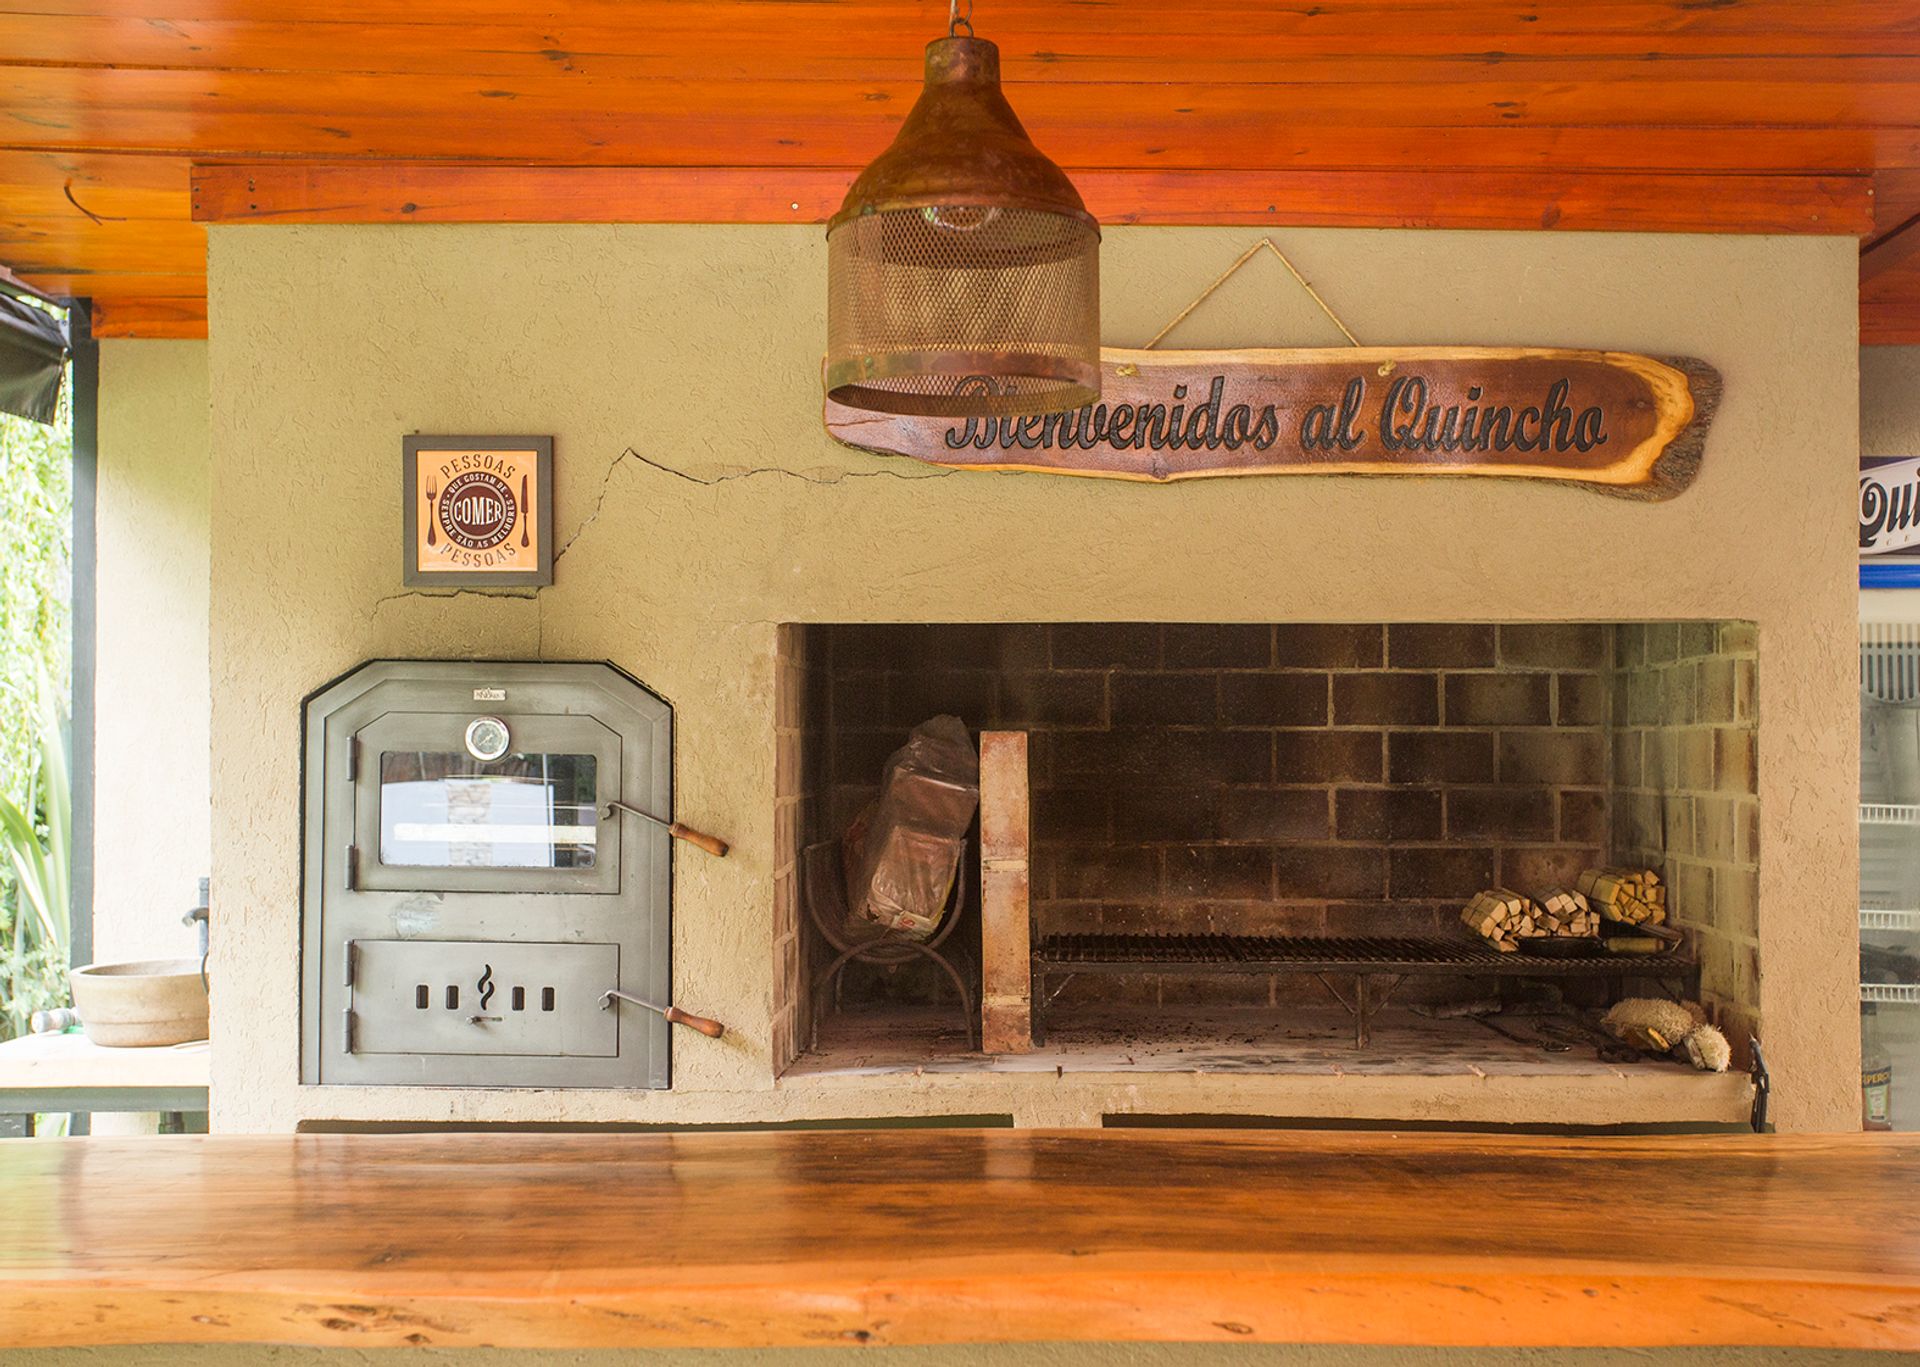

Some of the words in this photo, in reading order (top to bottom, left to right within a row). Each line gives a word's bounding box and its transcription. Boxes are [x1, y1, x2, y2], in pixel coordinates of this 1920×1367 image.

[945, 375, 1279, 450] Bienvenidos
[1301, 375, 1365, 451] al
[1379, 375, 1609, 453] Quincho
[440, 453, 516, 479] PESSOAS
[449, 475, 463, 494] QUE
[497, 480, 508, 494] DE
[441, 498, 455, 537] SEMPRE
[476, 539, 489, 549] AS
[491, 498, 516, 545] MELHORES
[454, 496, 502, 525] COMER
[440, 542, 516, 568] PESSOAS
